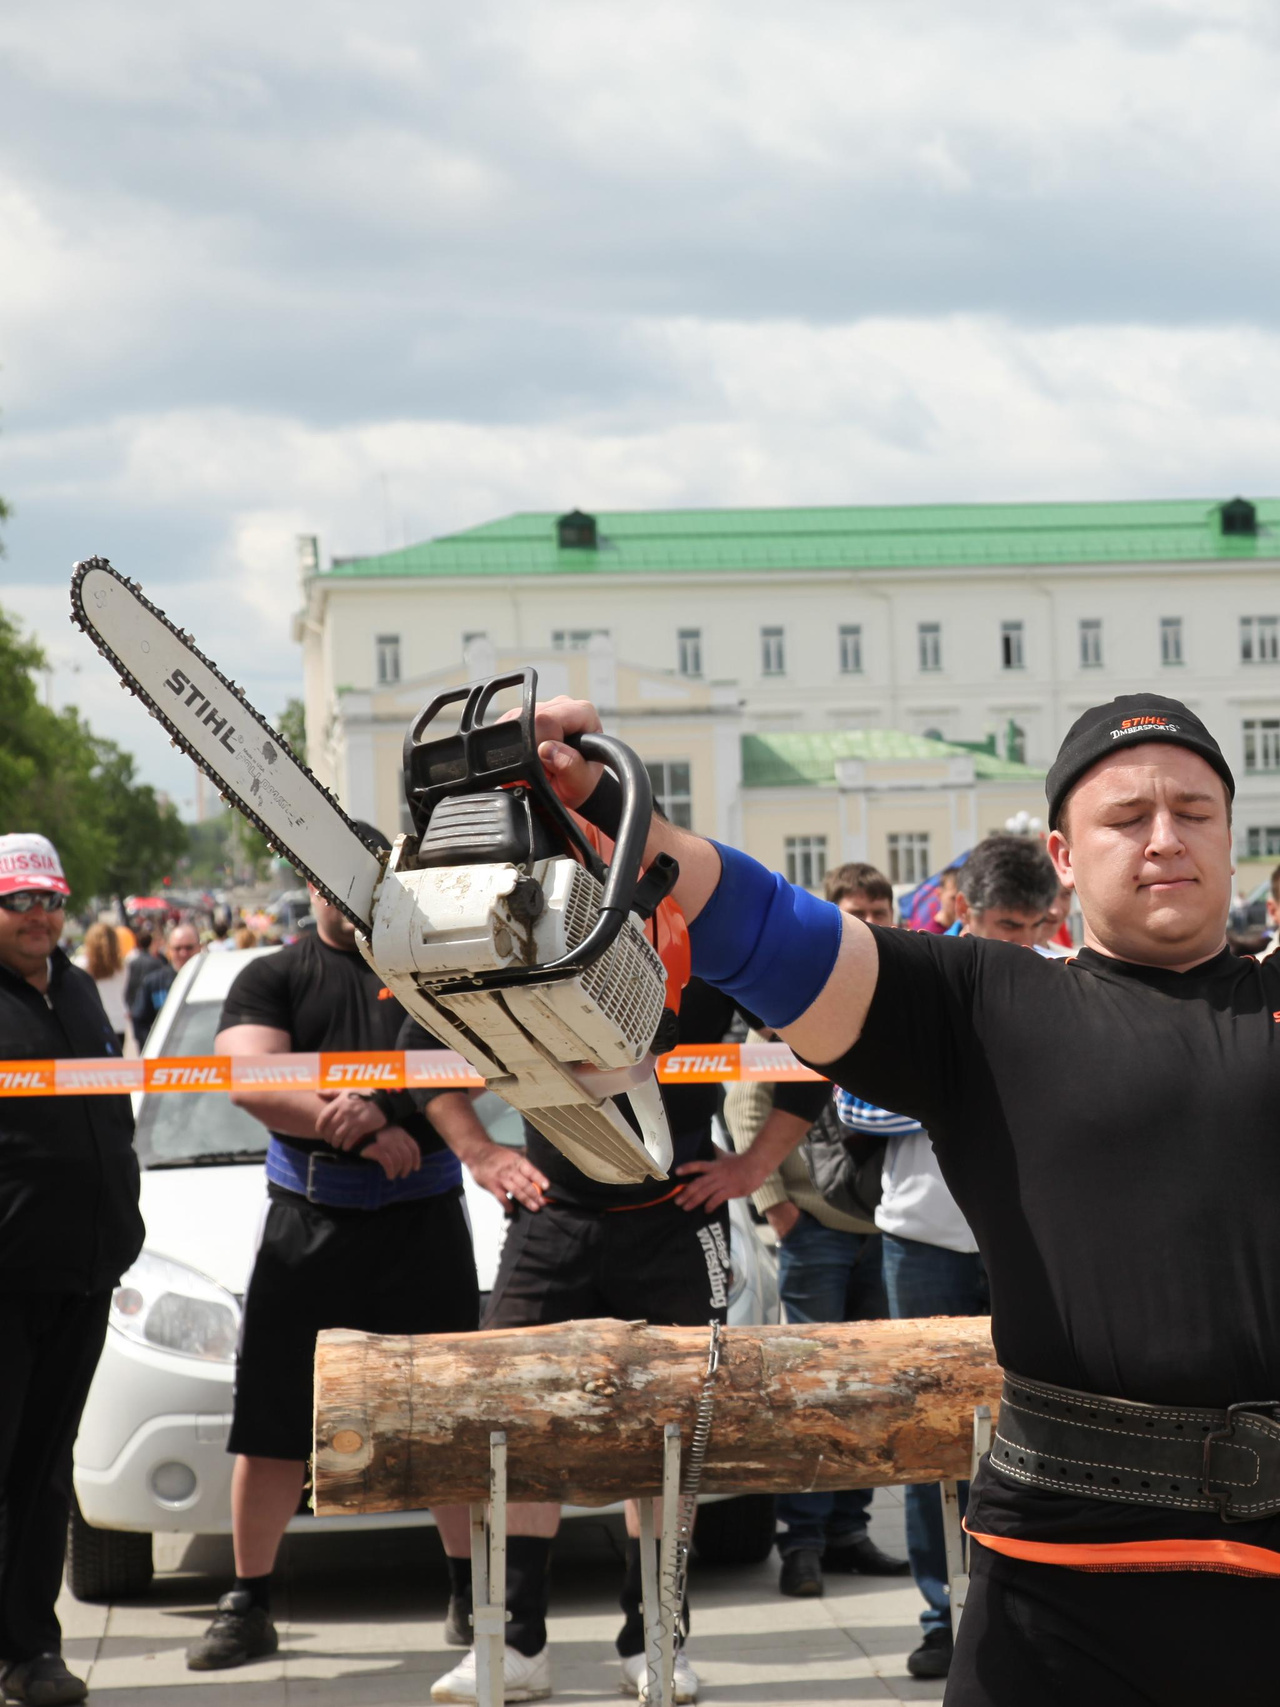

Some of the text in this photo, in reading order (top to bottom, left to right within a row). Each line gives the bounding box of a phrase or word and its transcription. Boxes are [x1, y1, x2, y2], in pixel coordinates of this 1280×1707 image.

[164, 668, 236, 754] STIHL
[1110, 724, 1177, 739] TIMBERSPORTS
[1121, 716, 1166, 730] STIHL
[325, 1064, 398, 1081] STIHL
[664, 1056, 733, 1073] STIHL
[150, 1067, 223, 1086] STIHL
[696, 1227, 727, 1308] wrestling
